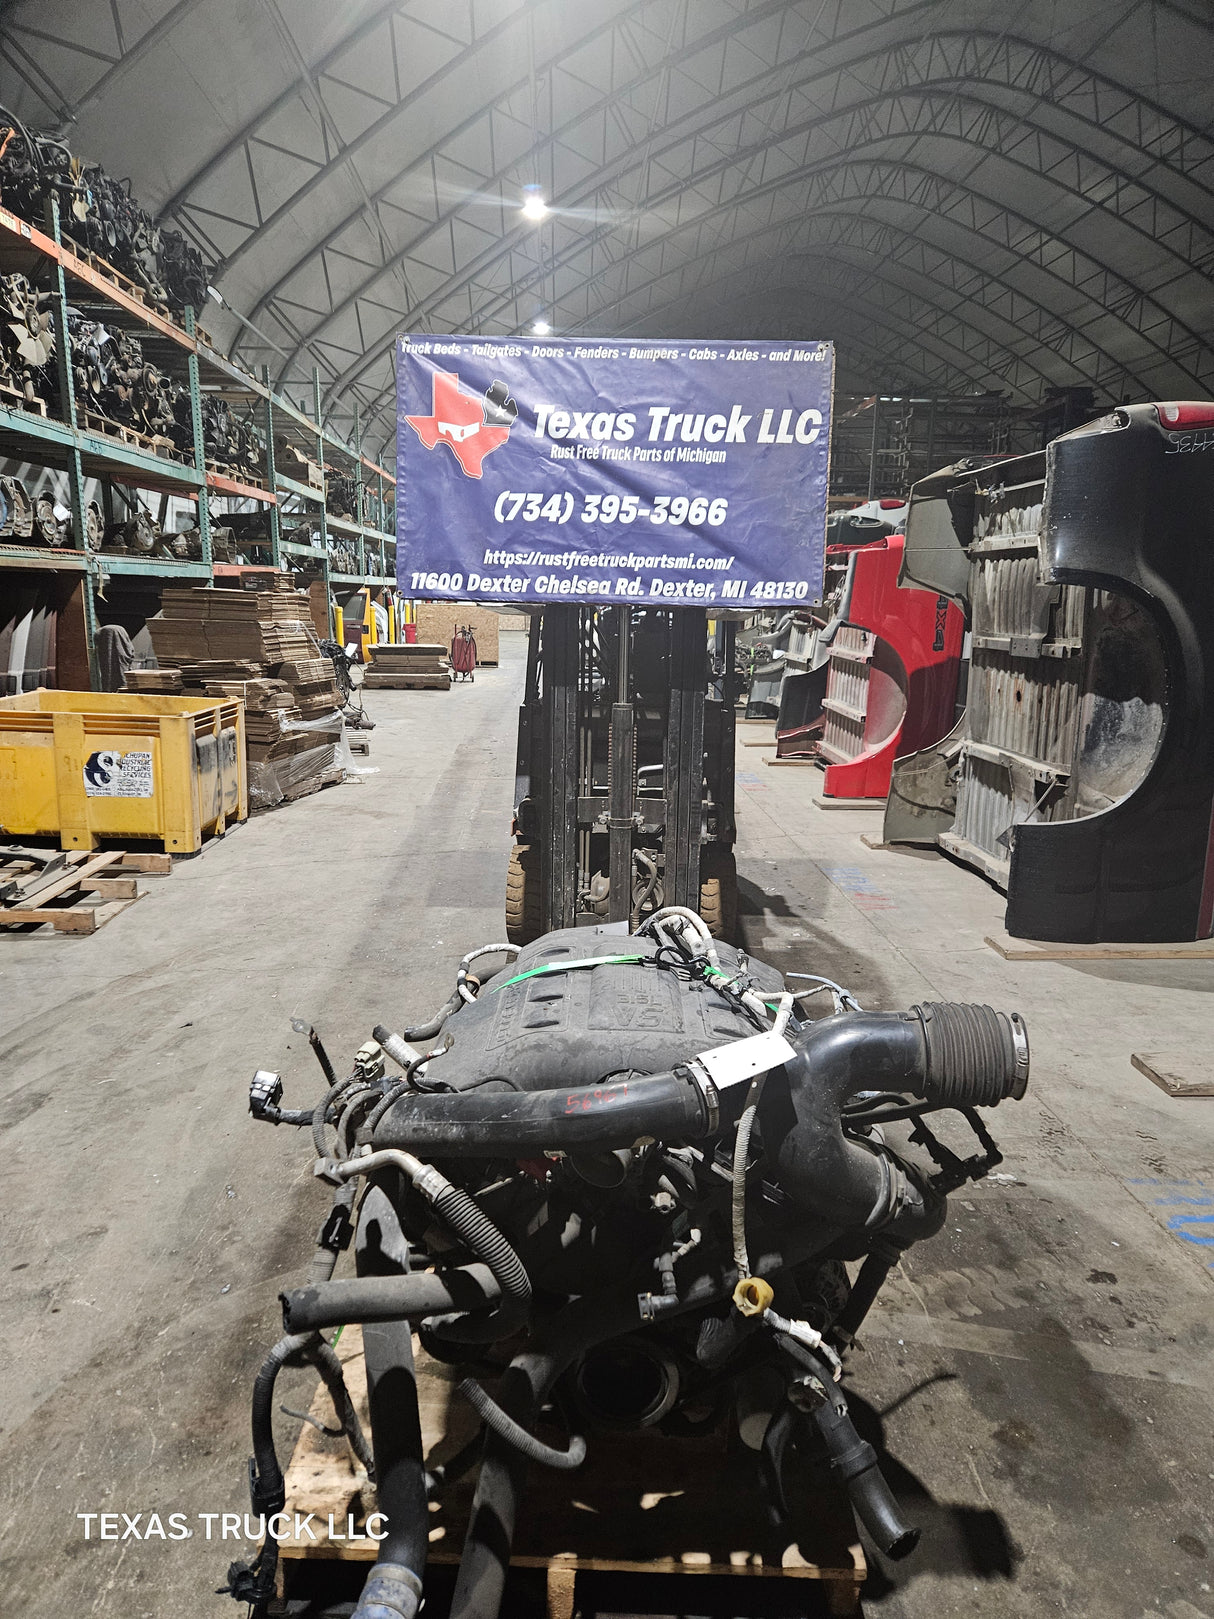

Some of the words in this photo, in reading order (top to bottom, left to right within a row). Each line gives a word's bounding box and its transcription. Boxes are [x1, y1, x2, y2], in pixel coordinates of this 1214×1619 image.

[402, 341, 431, 354] Truck
[433, 343, 461, 355] Beds
[471, 343, 522, 359] Tailgates
[532, 345, 564, 358] Doors
[574, 346, 619, 359] Fenders
[629, 347, 679, 362] Bumpers
[689, 348, 717, 360] Cabs
[726, 349, 759, 361] Axles
[769, 349, 789, 361] and
[793, 349, 827, 362] More!
[532, 404, 637, 441] Texas
[648, 405, 752, 443] Truck
[757, 408, 823, 445] LLC
[550, 443, 575, 460] Rust
[576, 444, 600, 460] Free
[601, 445, 632, 461] Truck
[633, 446, 662, 462] Parts
[663, 446, 676, 462] of
[676, 447, 727, 465] Michigan
[494, 490, 575, 525] (734)
[581, 494, 729, 526] 395-3966
[483, 549, 735, 571] https://rustfreetruckpartsmi.com/
[410, 572, 463, 591] 11600
[466, 574, 530, 593] Dexter
[534, 575, 611, 595] Chelsea
[615, 576, 645, 596] Rd.
[650, 578, 716, 600] Dexter,
[721, 580, 748, 599] MI
[750, 581, 809, 600] 48130
